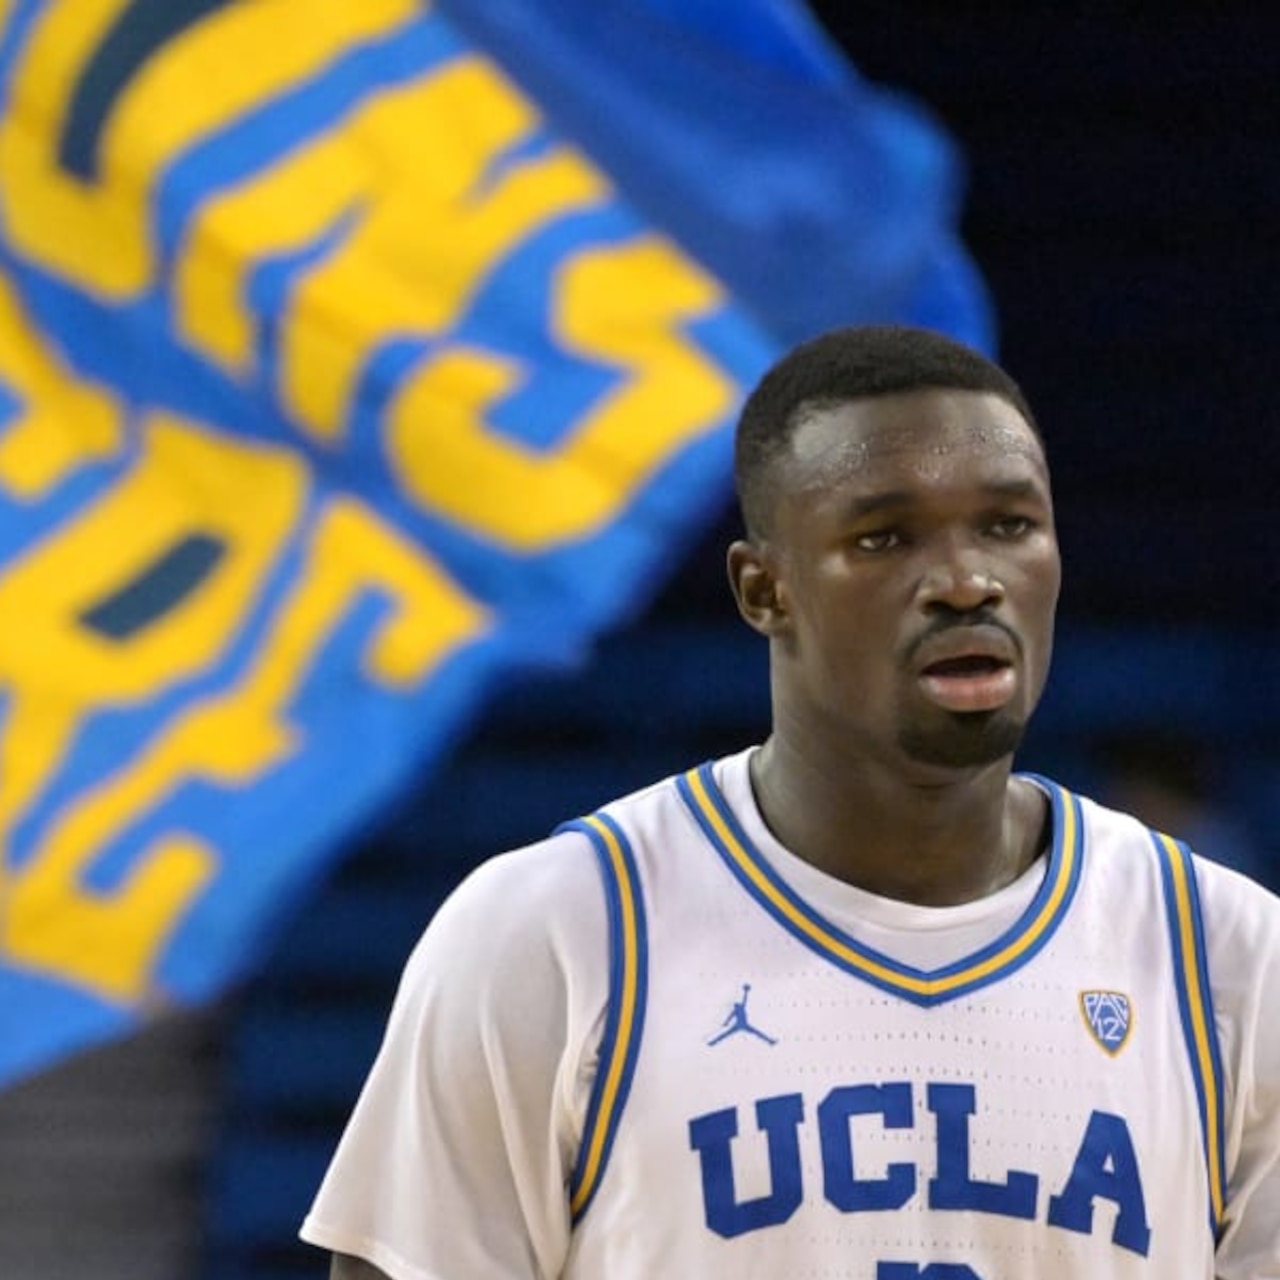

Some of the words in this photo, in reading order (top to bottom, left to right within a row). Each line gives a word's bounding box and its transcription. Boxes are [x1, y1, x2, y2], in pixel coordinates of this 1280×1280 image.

[1083, 993, 1128, 1030] PAC
[1096, 1016, 1122, 1040] 12
[688, 1081, 1152, 1258] UCLA
